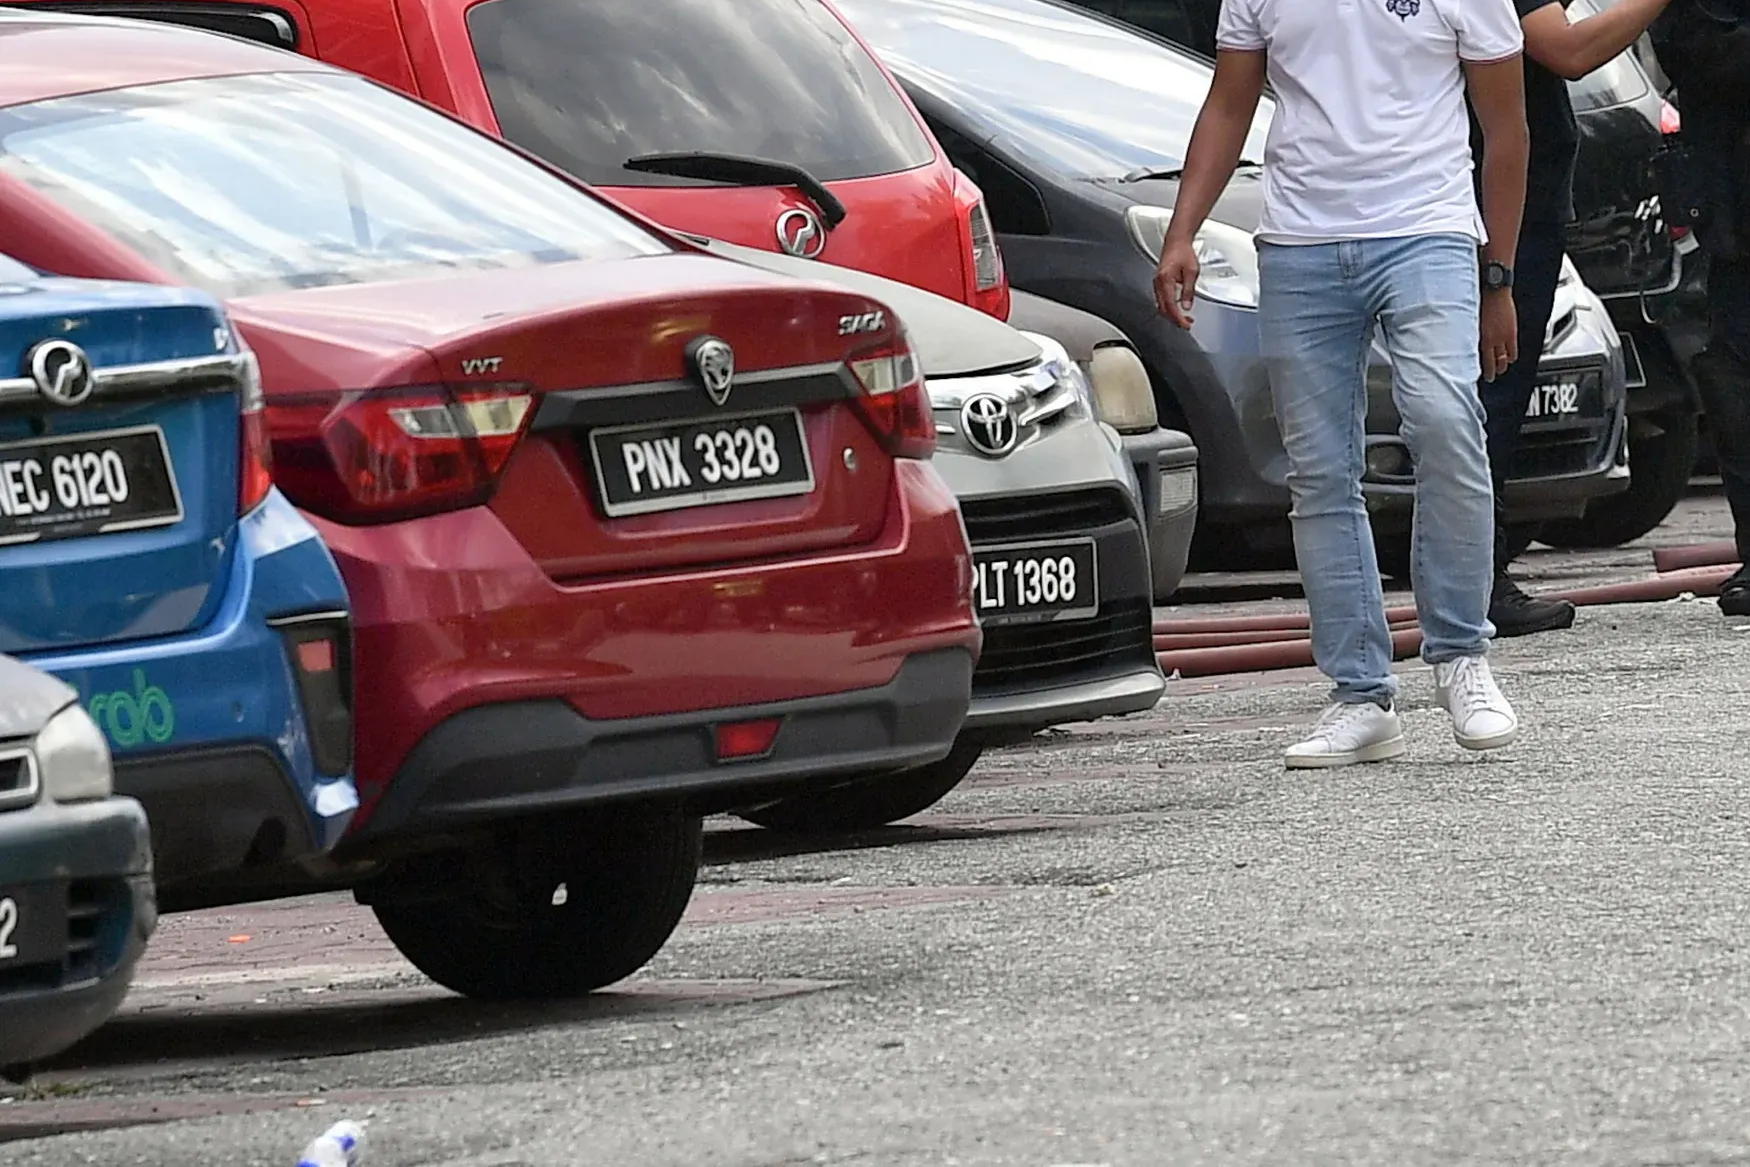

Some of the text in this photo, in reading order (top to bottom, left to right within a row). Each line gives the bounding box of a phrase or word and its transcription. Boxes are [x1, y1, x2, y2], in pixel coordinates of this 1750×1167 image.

[461, 357, 503, 375] VVT
[1541, 383, 1579, 414] 7382
[52, 449, 129, 508] 6120
[621, 425, 780, 493] PNX 3328
[1013, 556, 1076, 606] 1368
[84, 669, 174, 746] rab
